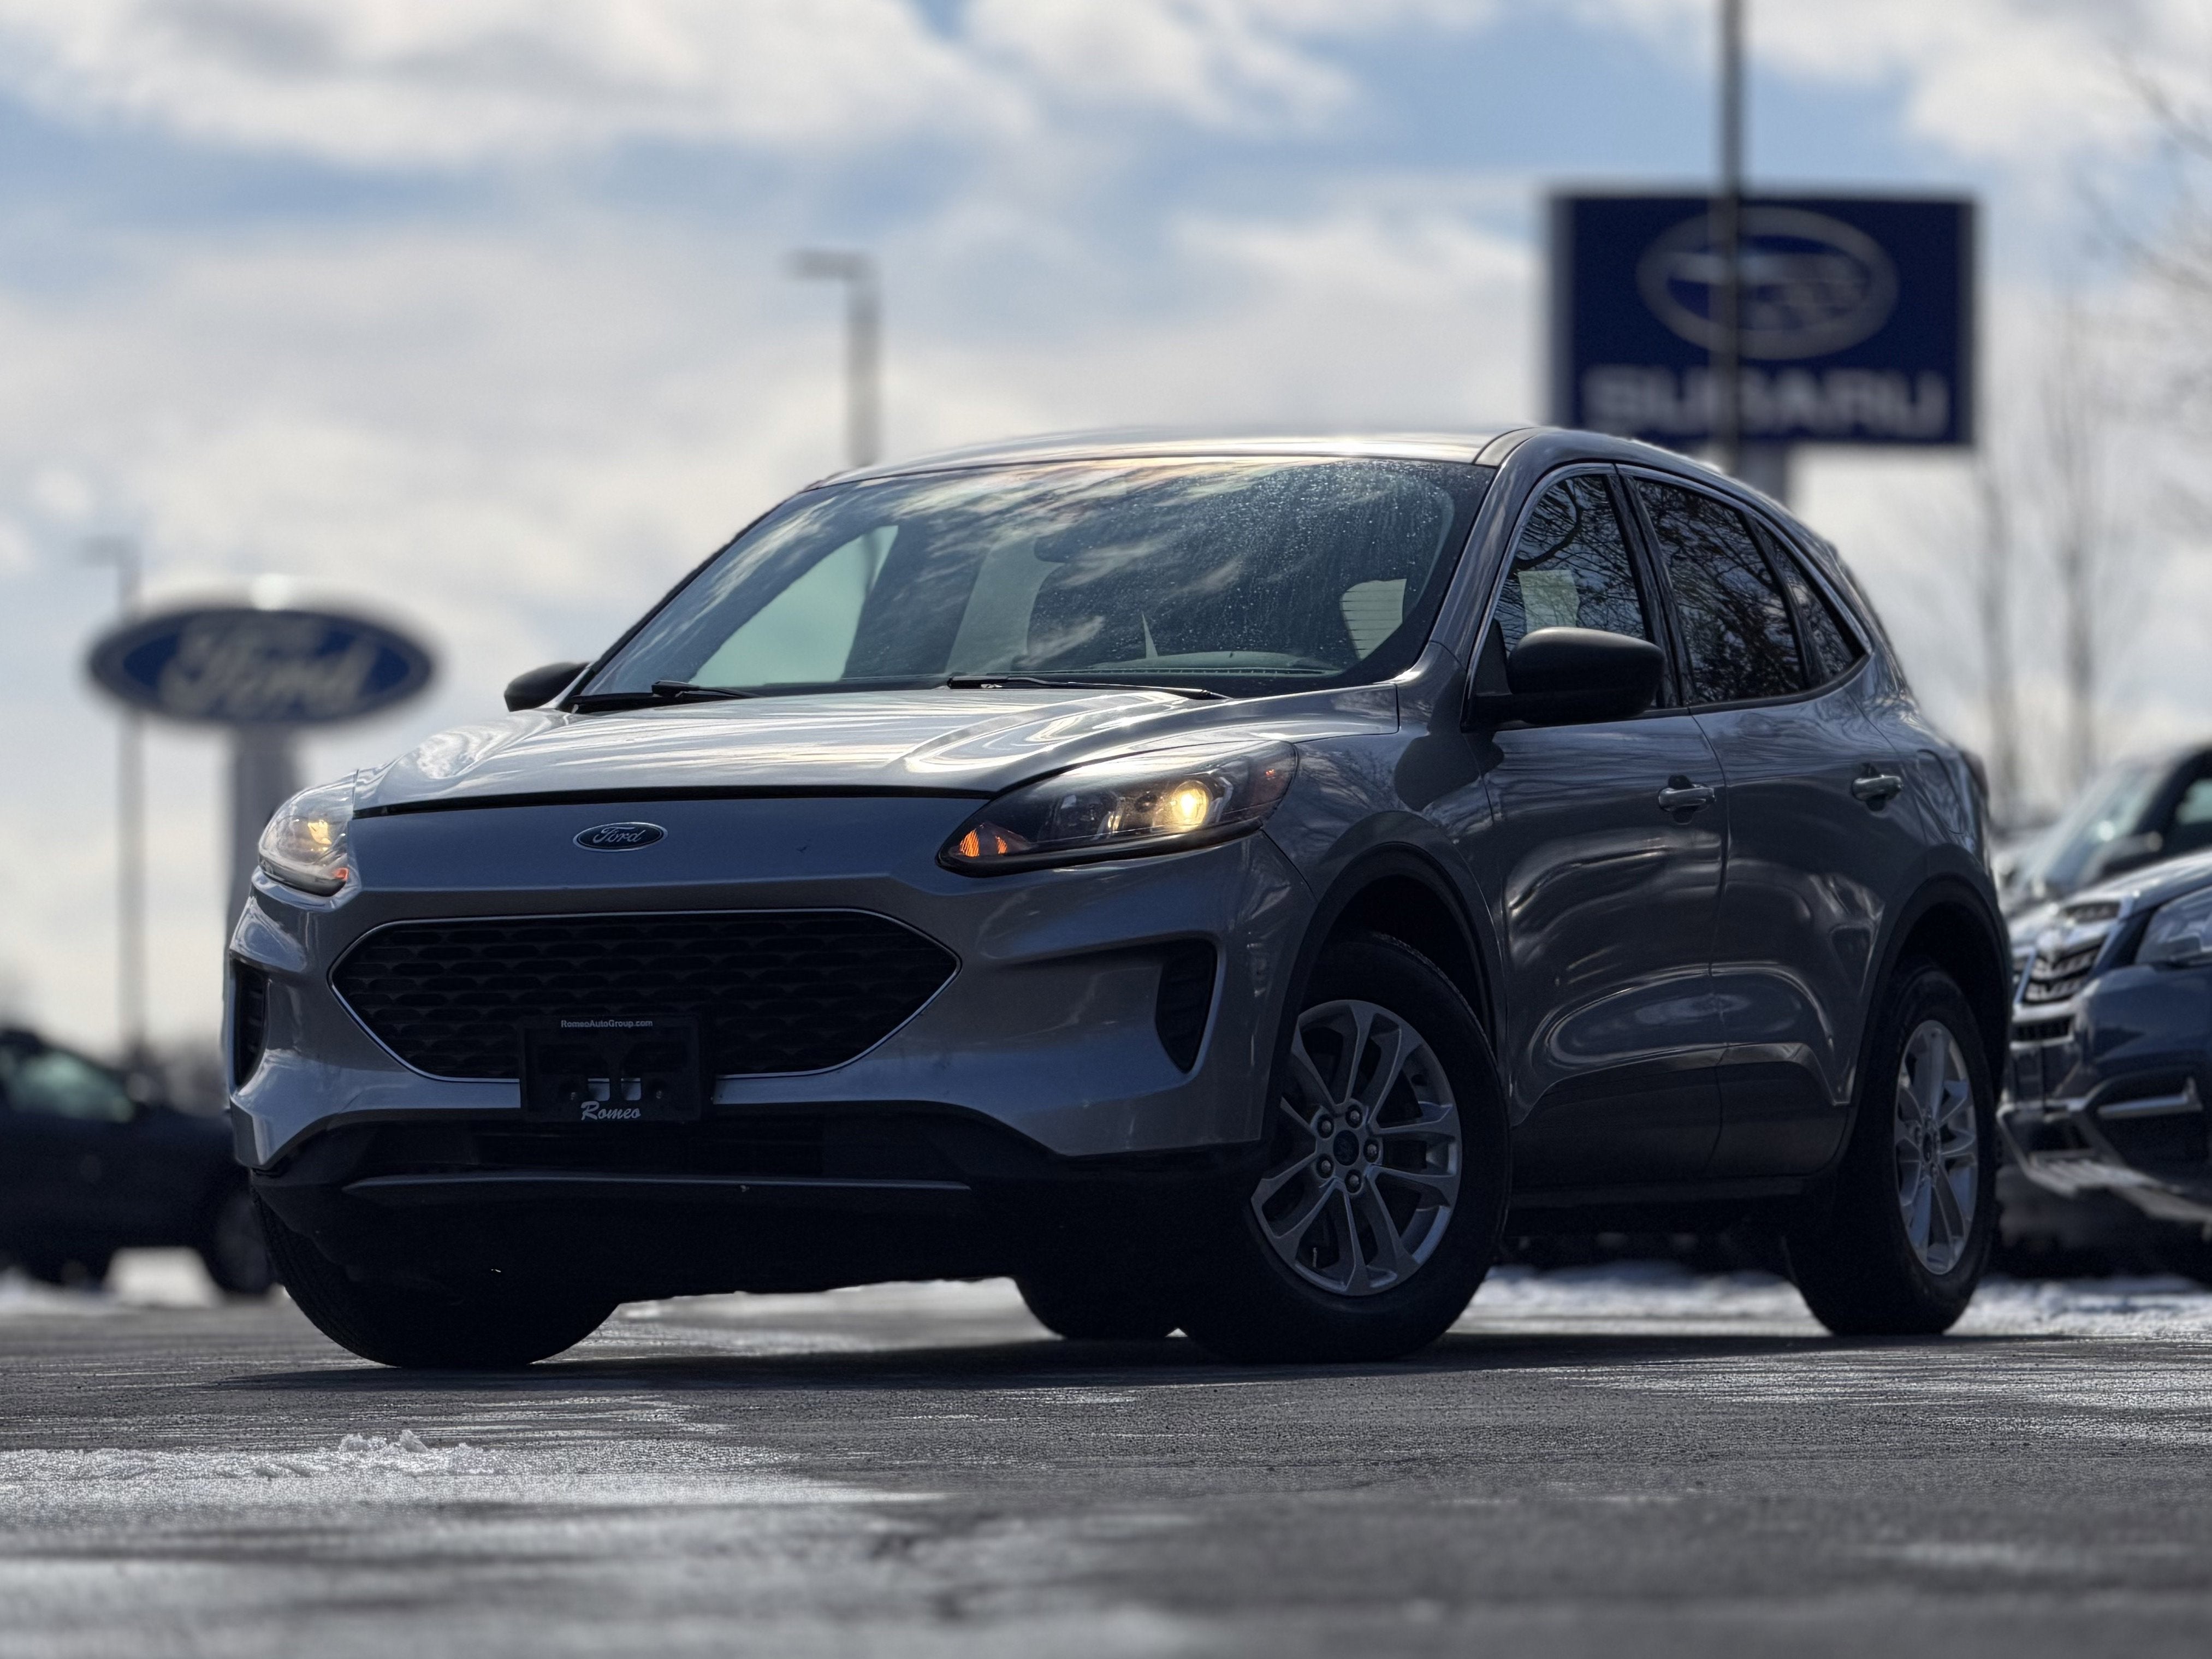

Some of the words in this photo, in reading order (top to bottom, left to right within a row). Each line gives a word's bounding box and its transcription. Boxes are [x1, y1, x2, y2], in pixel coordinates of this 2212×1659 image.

[592, 826, 647, 844] Ford
[561, 1019, 653, 1029] RomeoAutoGroup.com
[580, 1100, 642, 1121] Romeo
